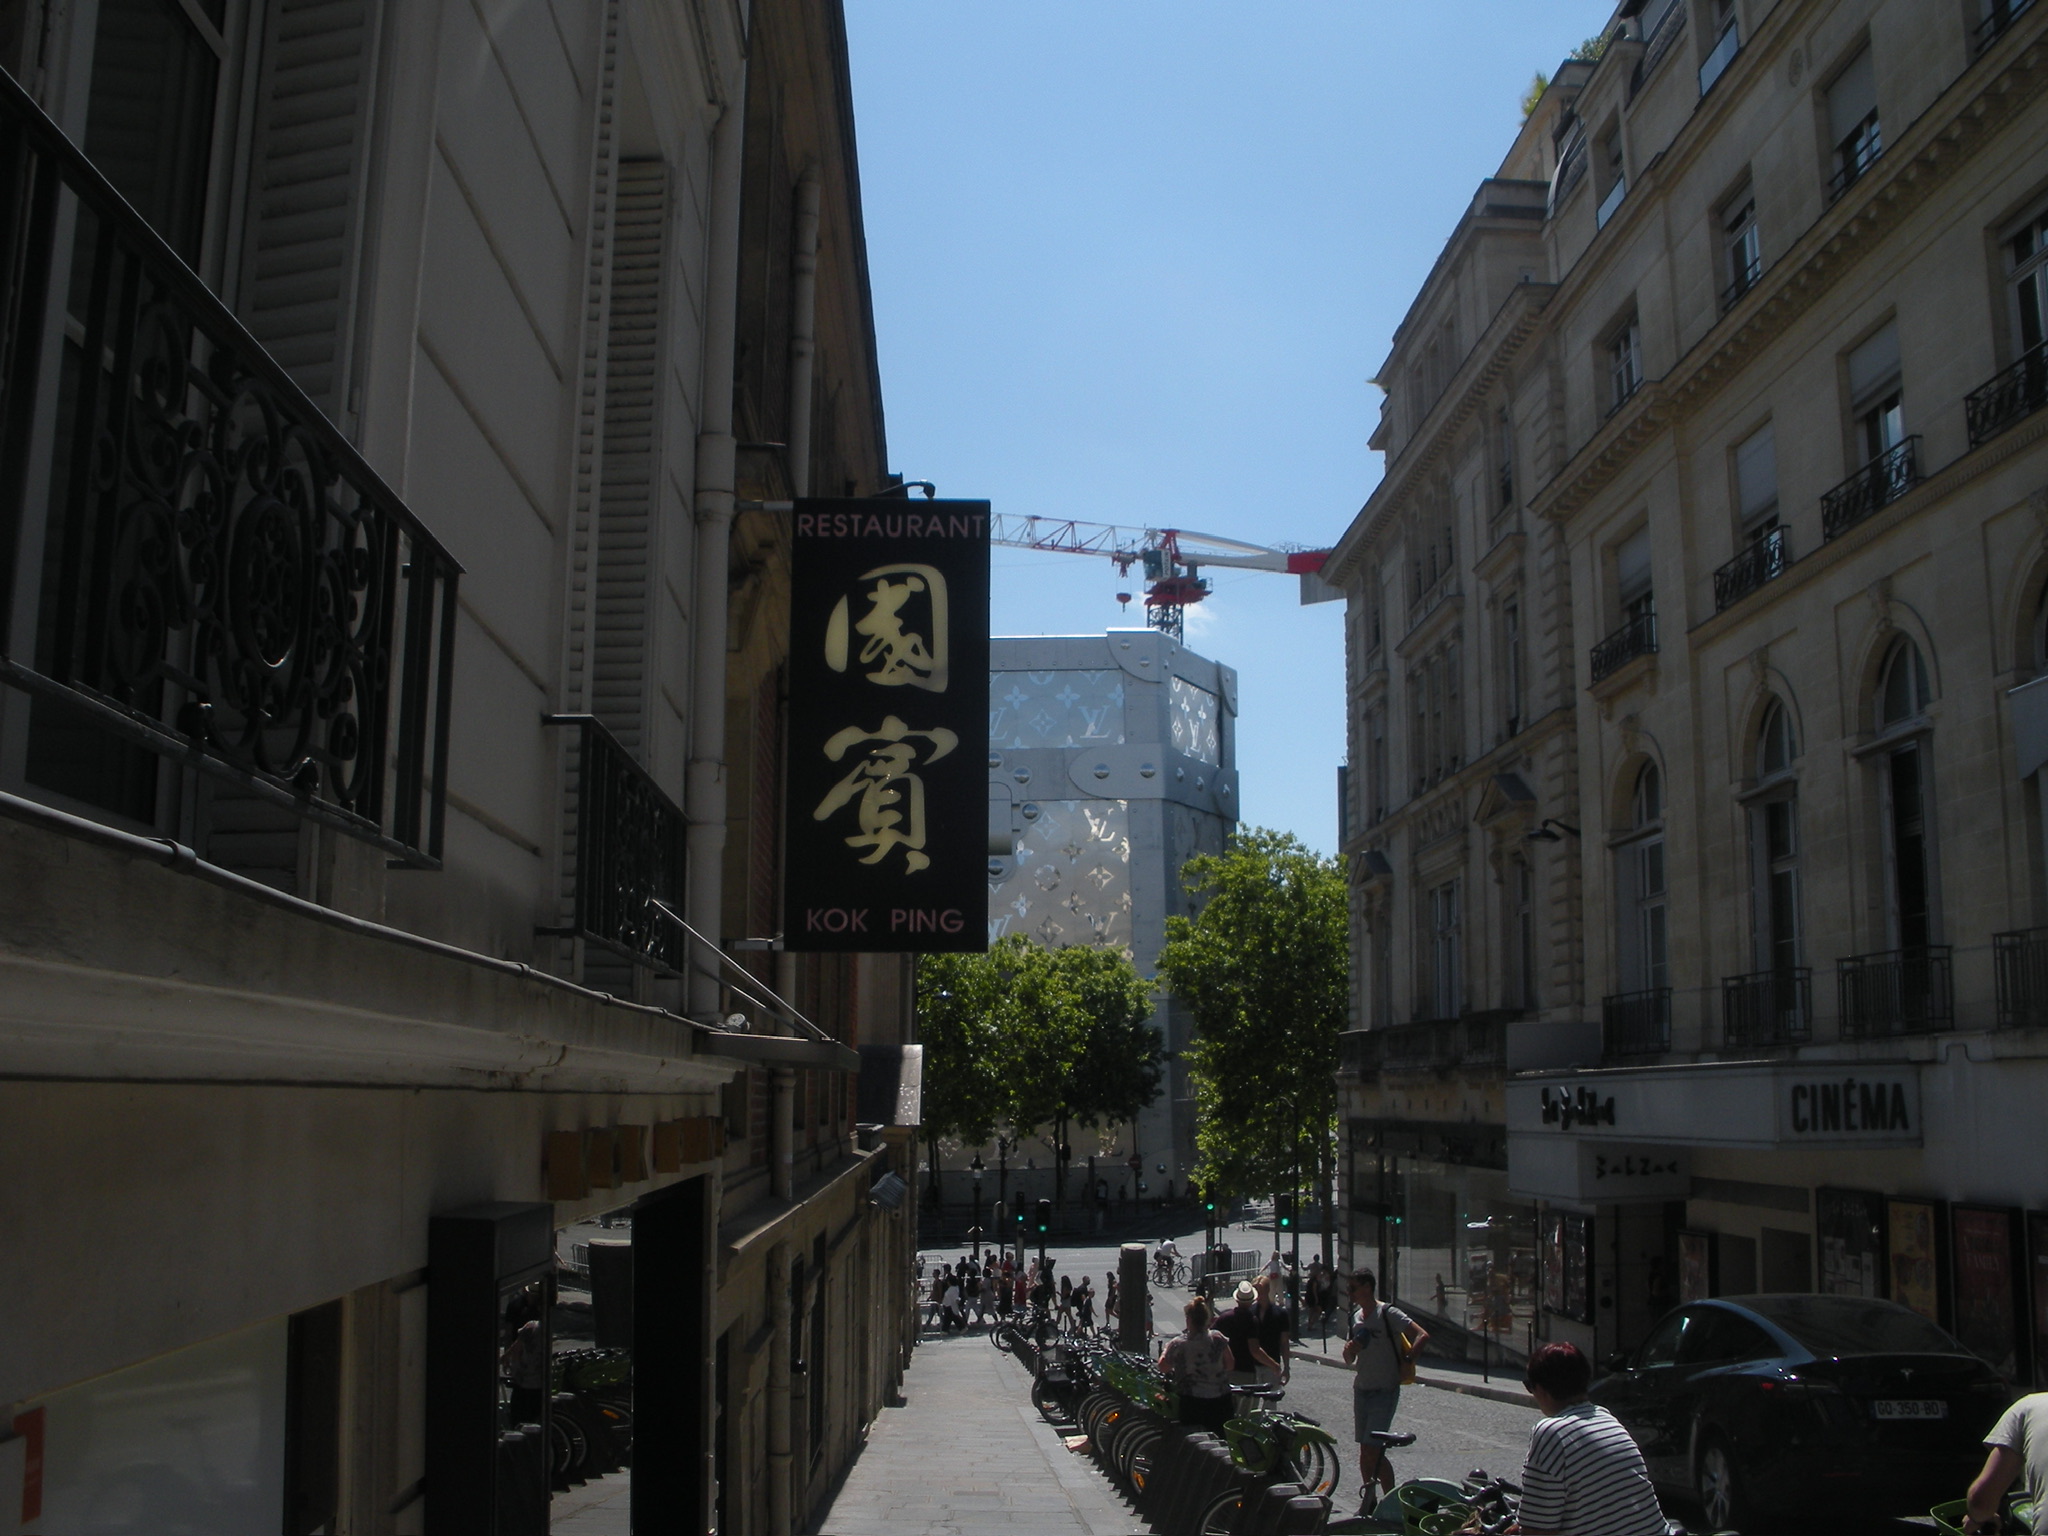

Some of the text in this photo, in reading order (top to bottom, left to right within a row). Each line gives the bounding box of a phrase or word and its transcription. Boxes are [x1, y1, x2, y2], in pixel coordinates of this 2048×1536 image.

[797, 513, 985, 538] RESTAURANT
[805, 908, 869, 933] KOK
[890, 908, 965, 933] PING
[1791, 1077, 1910, 1132] CINÉMA
